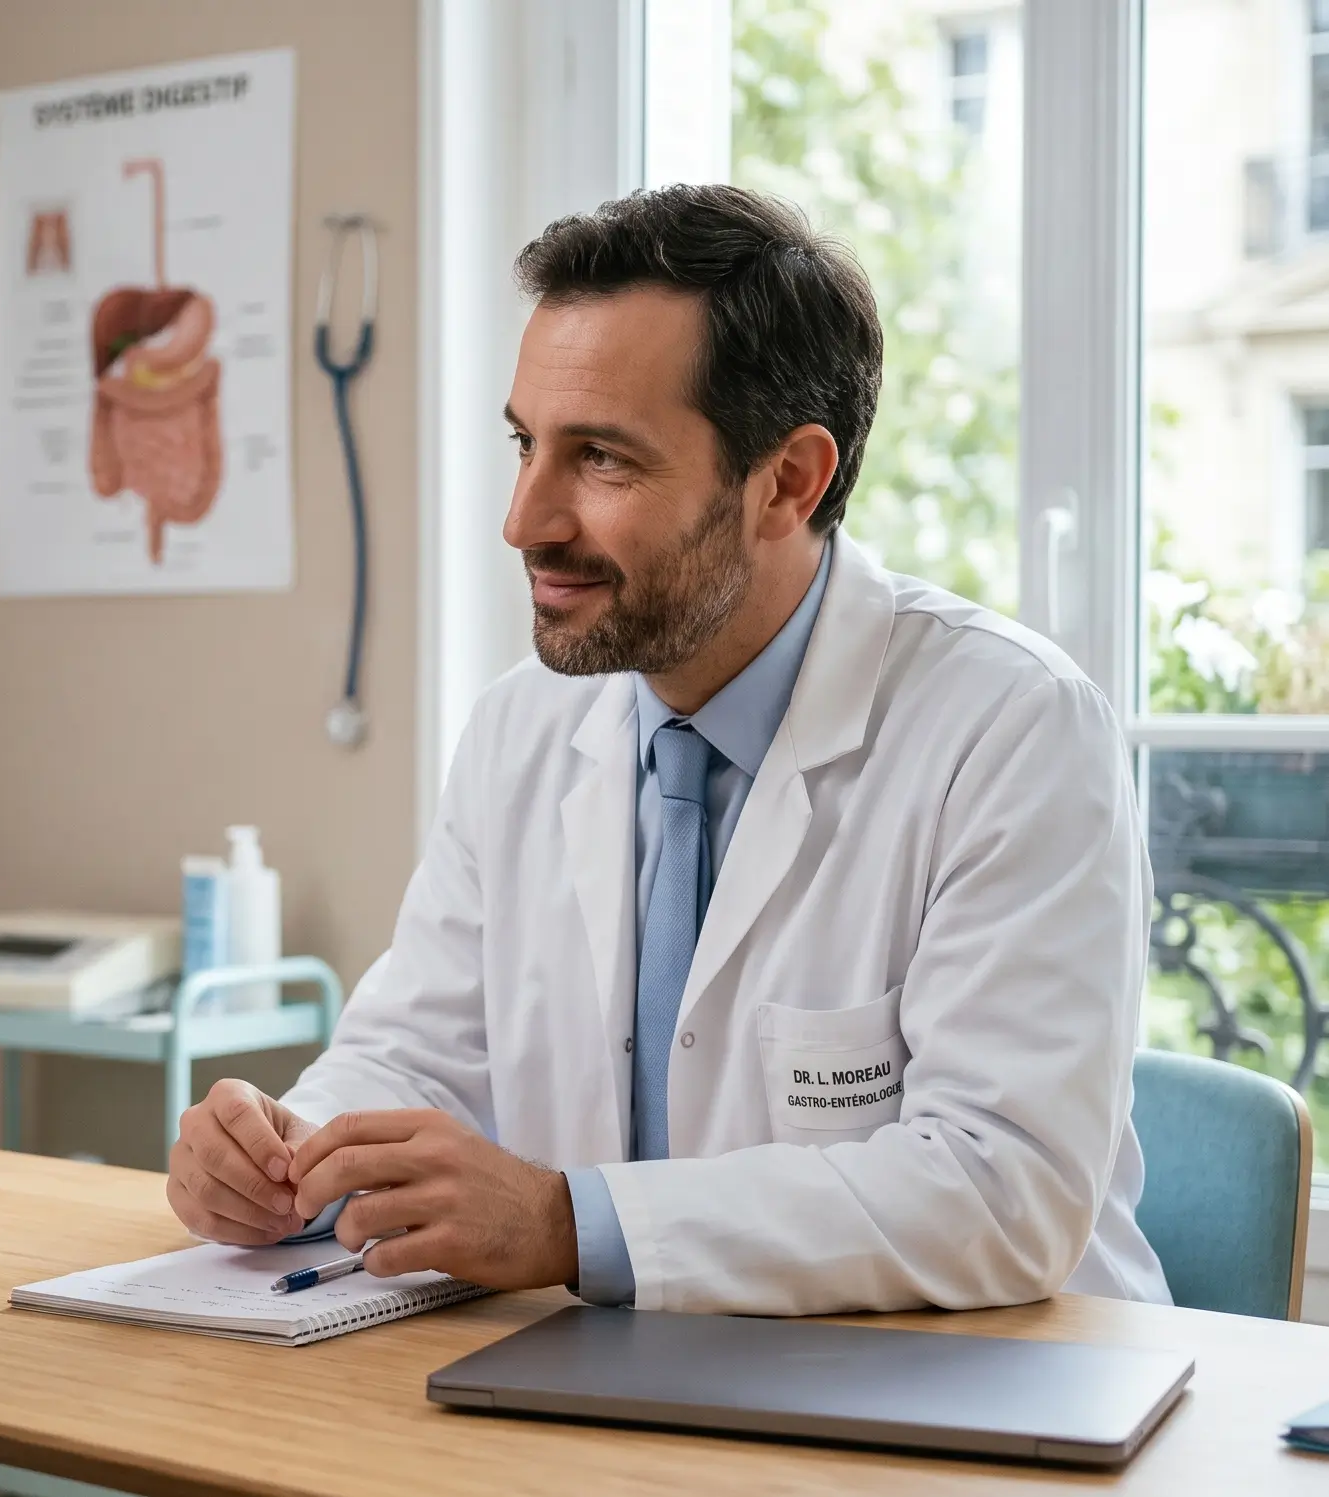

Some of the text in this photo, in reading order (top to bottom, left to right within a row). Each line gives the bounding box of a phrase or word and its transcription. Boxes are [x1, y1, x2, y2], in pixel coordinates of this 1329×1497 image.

[793, 1060, 891, 1085] DR. L. MOREAU
